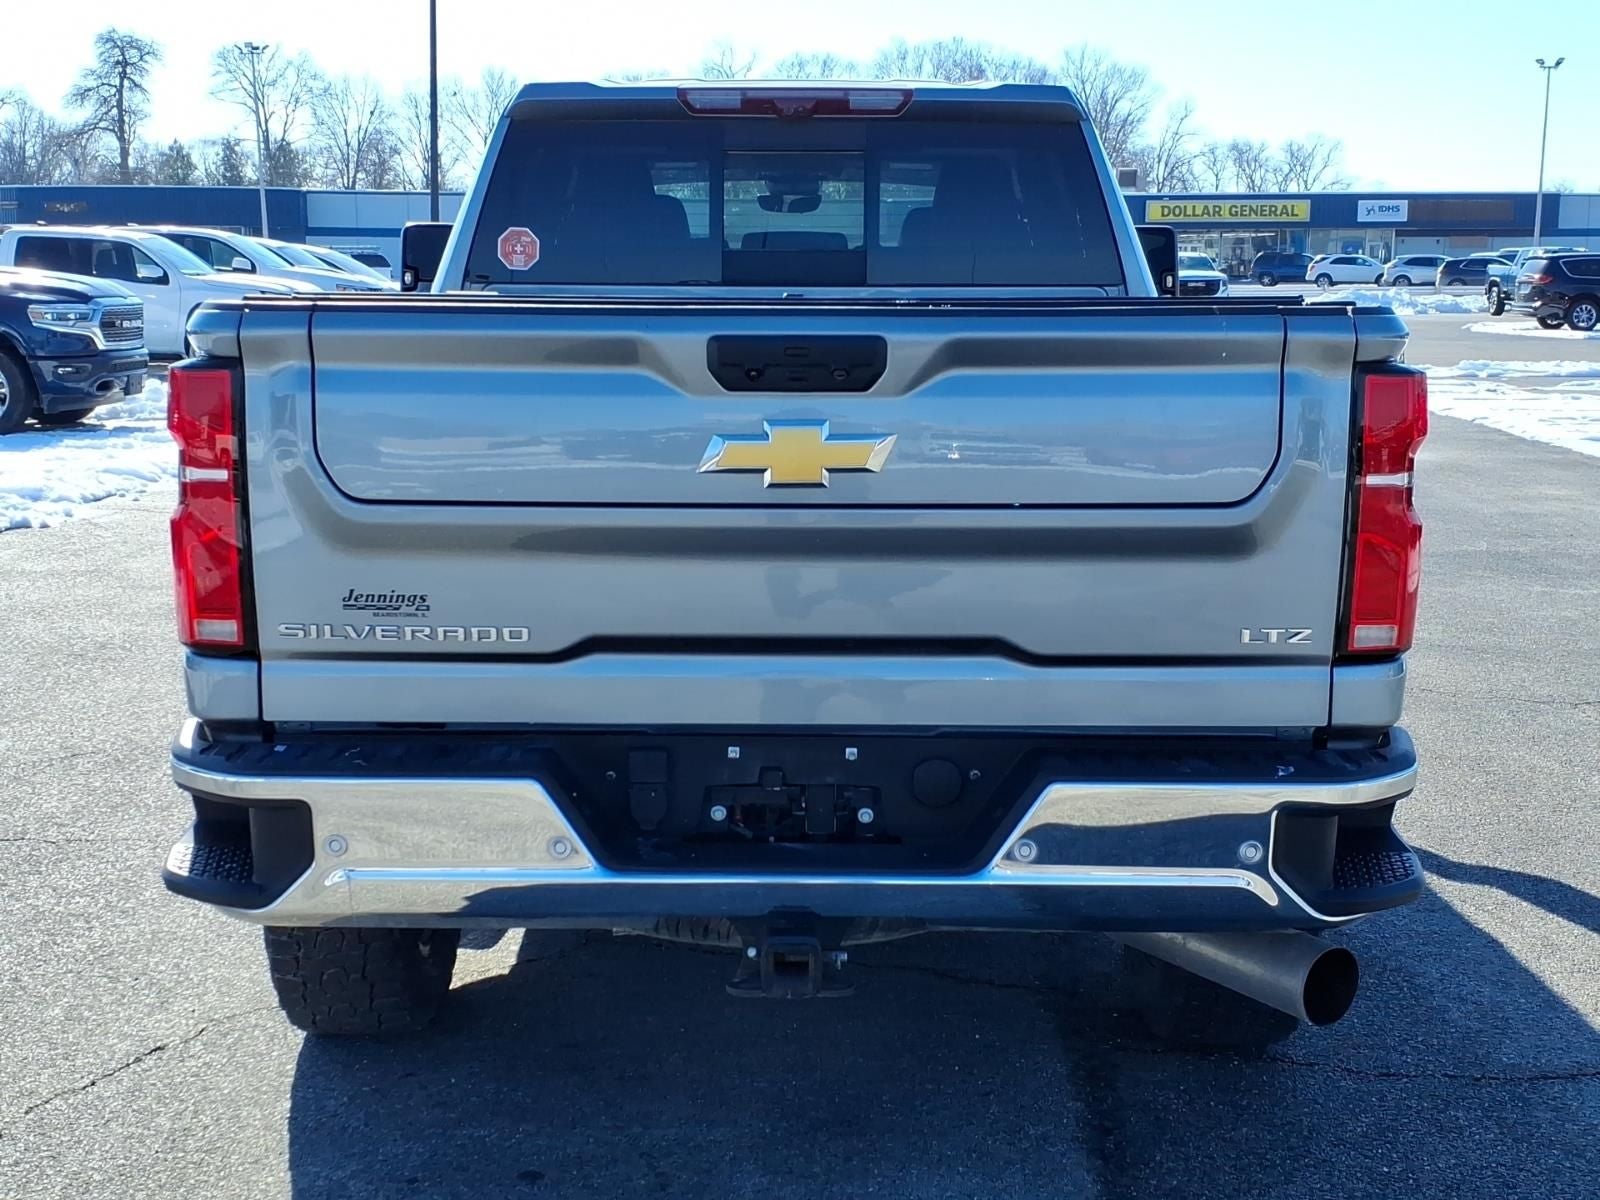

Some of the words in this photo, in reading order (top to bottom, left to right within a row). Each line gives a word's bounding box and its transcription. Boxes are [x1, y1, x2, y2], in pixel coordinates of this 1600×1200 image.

[1160, 204, 1223, 218] DOLLAR
[1228, 204, 1299, 217] GENERAL
[1377, 205, 1401, 213] IDHS
[342, 588, 428, 607] Jennings
[277, 622, 531, 643] SILVERADO
[1240, 628, 1312, 644] LTZ
